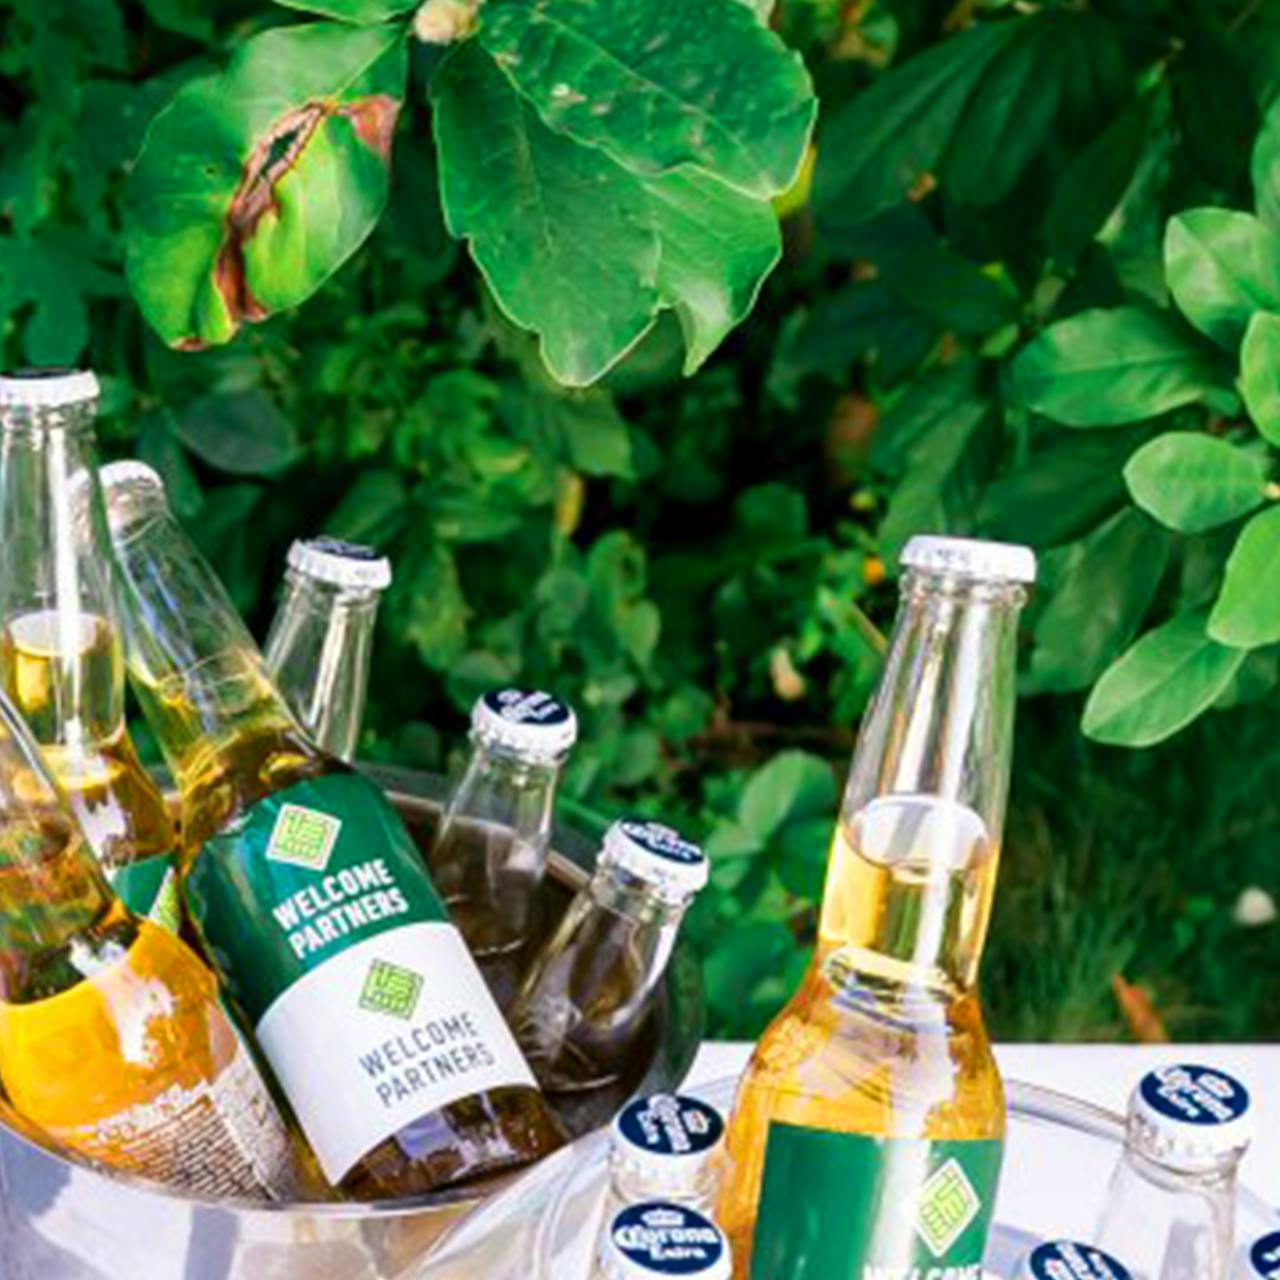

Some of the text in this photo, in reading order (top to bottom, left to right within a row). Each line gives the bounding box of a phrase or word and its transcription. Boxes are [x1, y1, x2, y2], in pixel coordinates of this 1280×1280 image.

[273, 858, 395, 931] WELCOME
[288, 887, 410, 960] PARTNERS
[358, 1012, 479, 1079] WELCOME
[375, 1041, 496, 1108] PARTNERS
[614, 1224, 720, 1250] Corona
[650, 1243, 709, 1261] Extra
